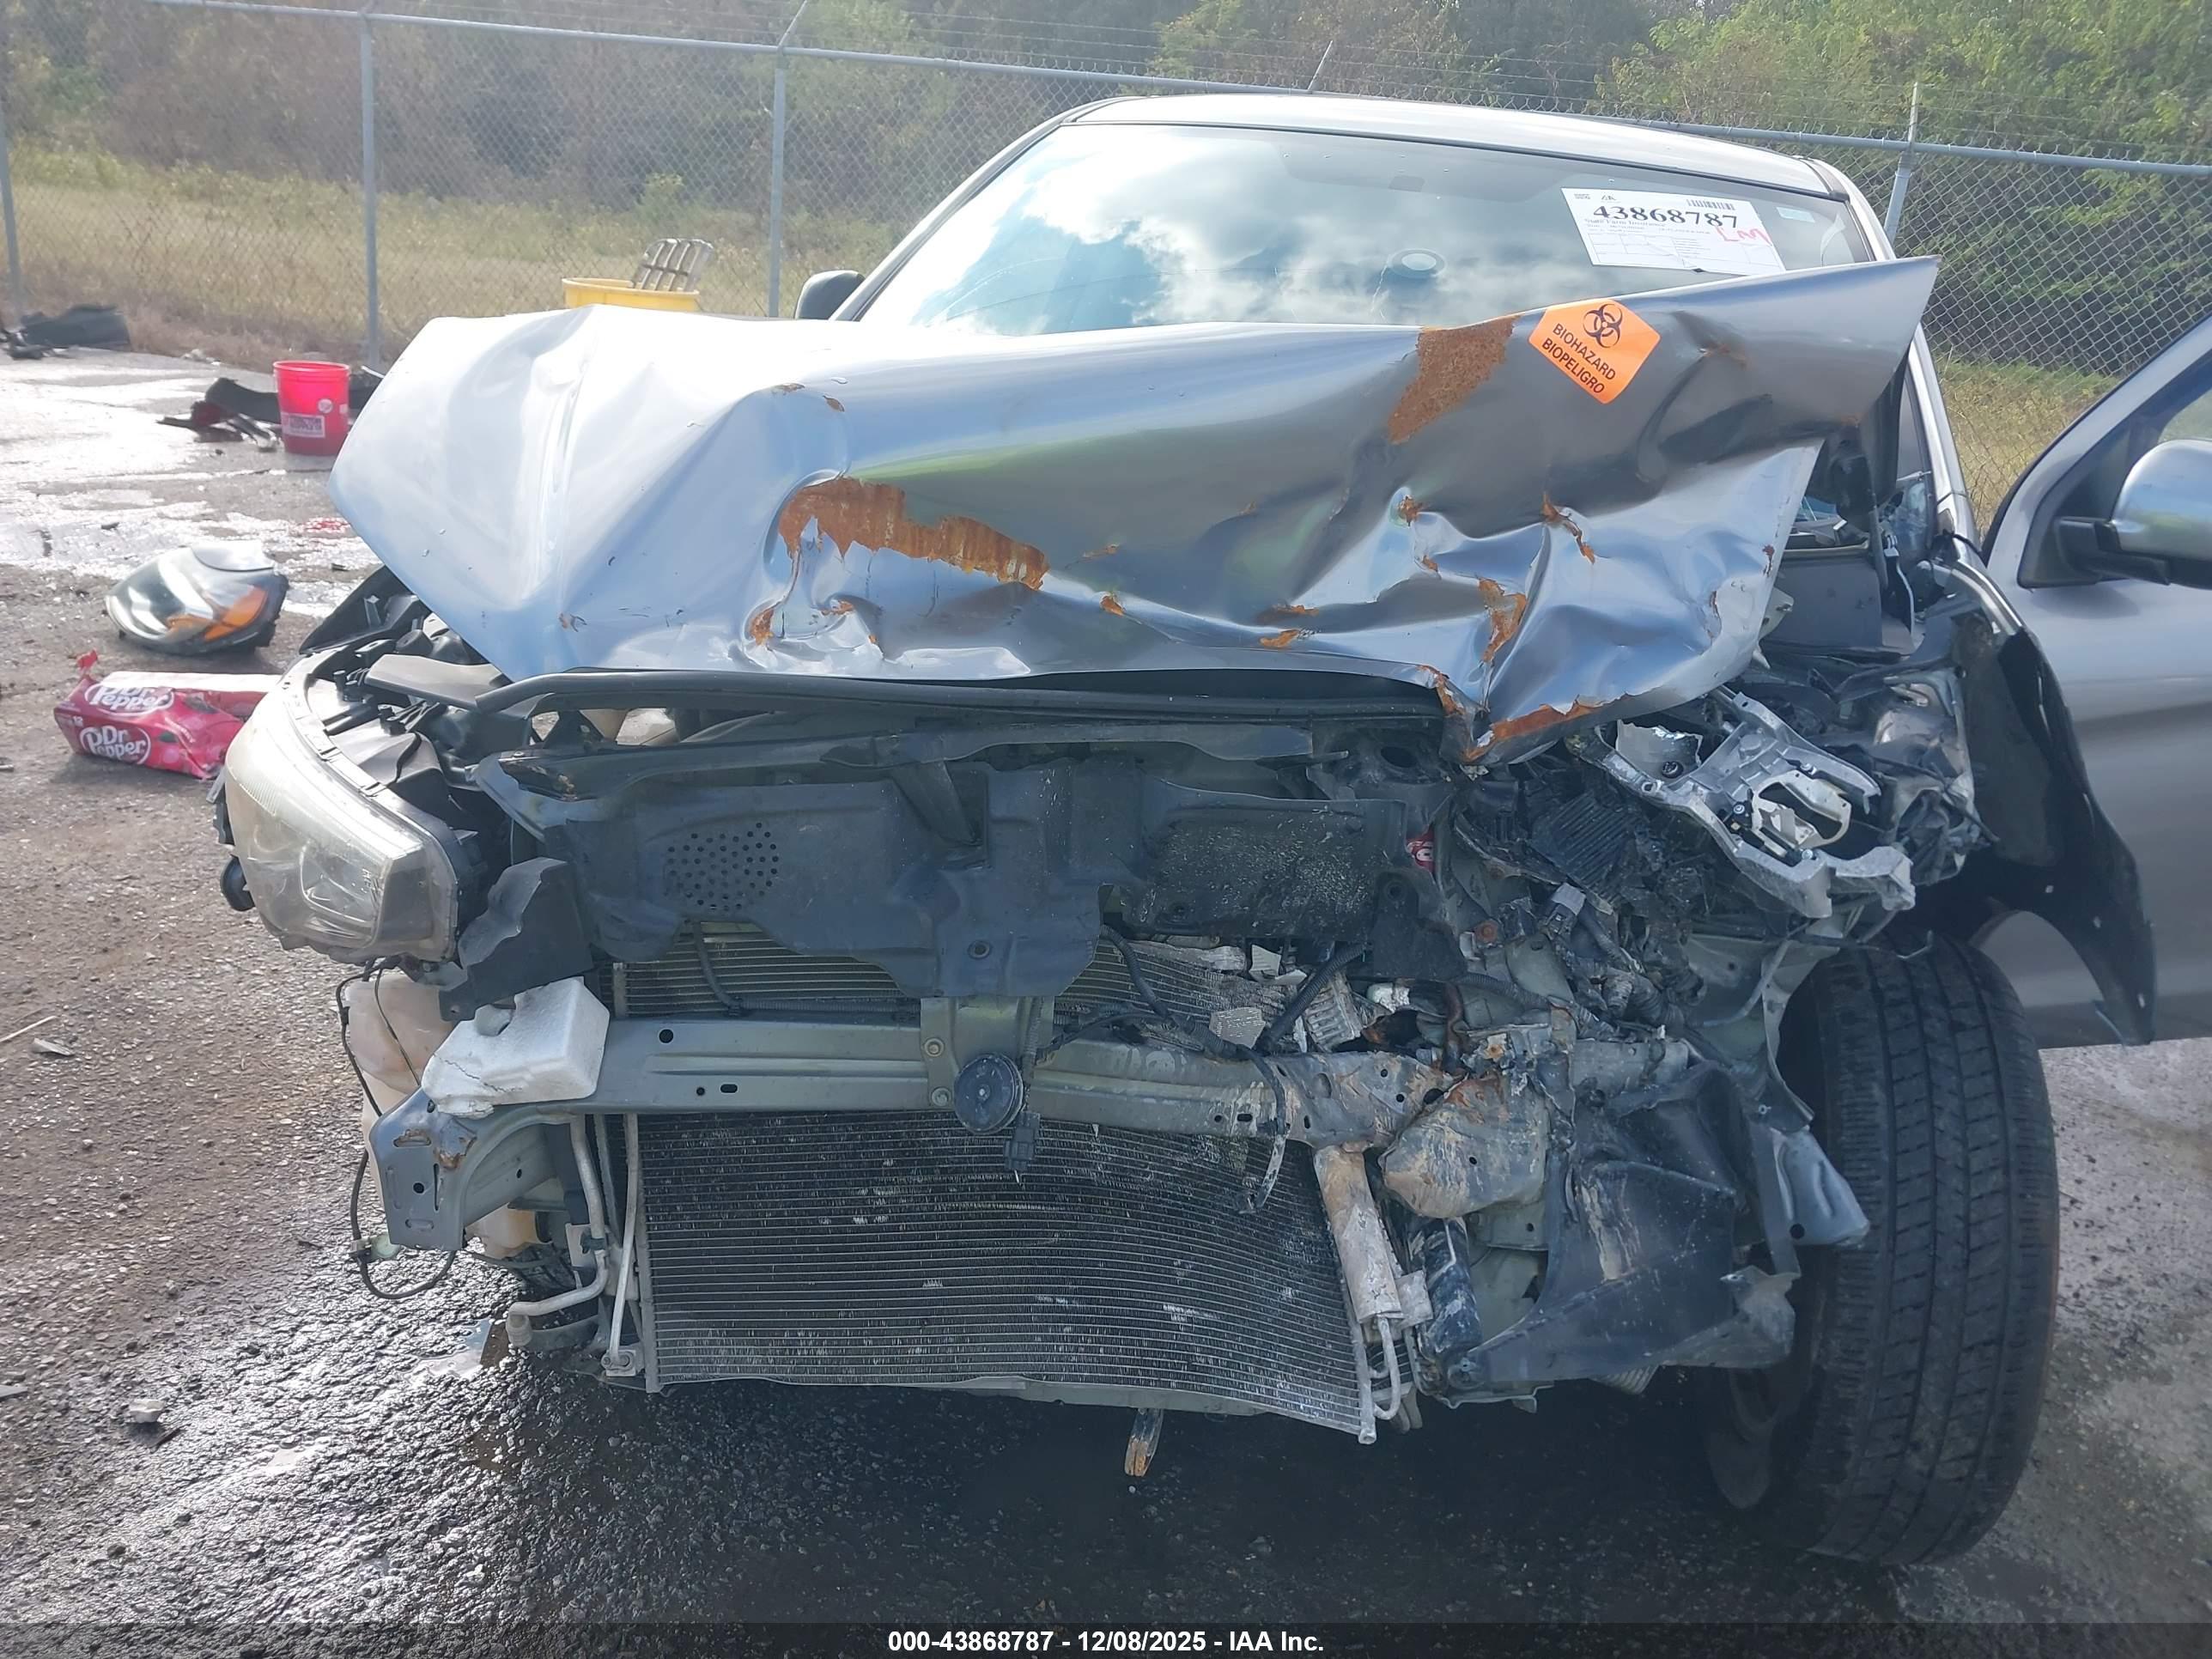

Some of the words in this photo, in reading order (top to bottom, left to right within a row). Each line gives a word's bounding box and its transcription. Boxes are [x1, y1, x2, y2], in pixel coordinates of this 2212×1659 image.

[1593, 205, 1737, 228] 43868787
[1541, 337, 1605, 393] BIOPELIGRO
[1552, 323, 1616, 380] BIOHAZARD
